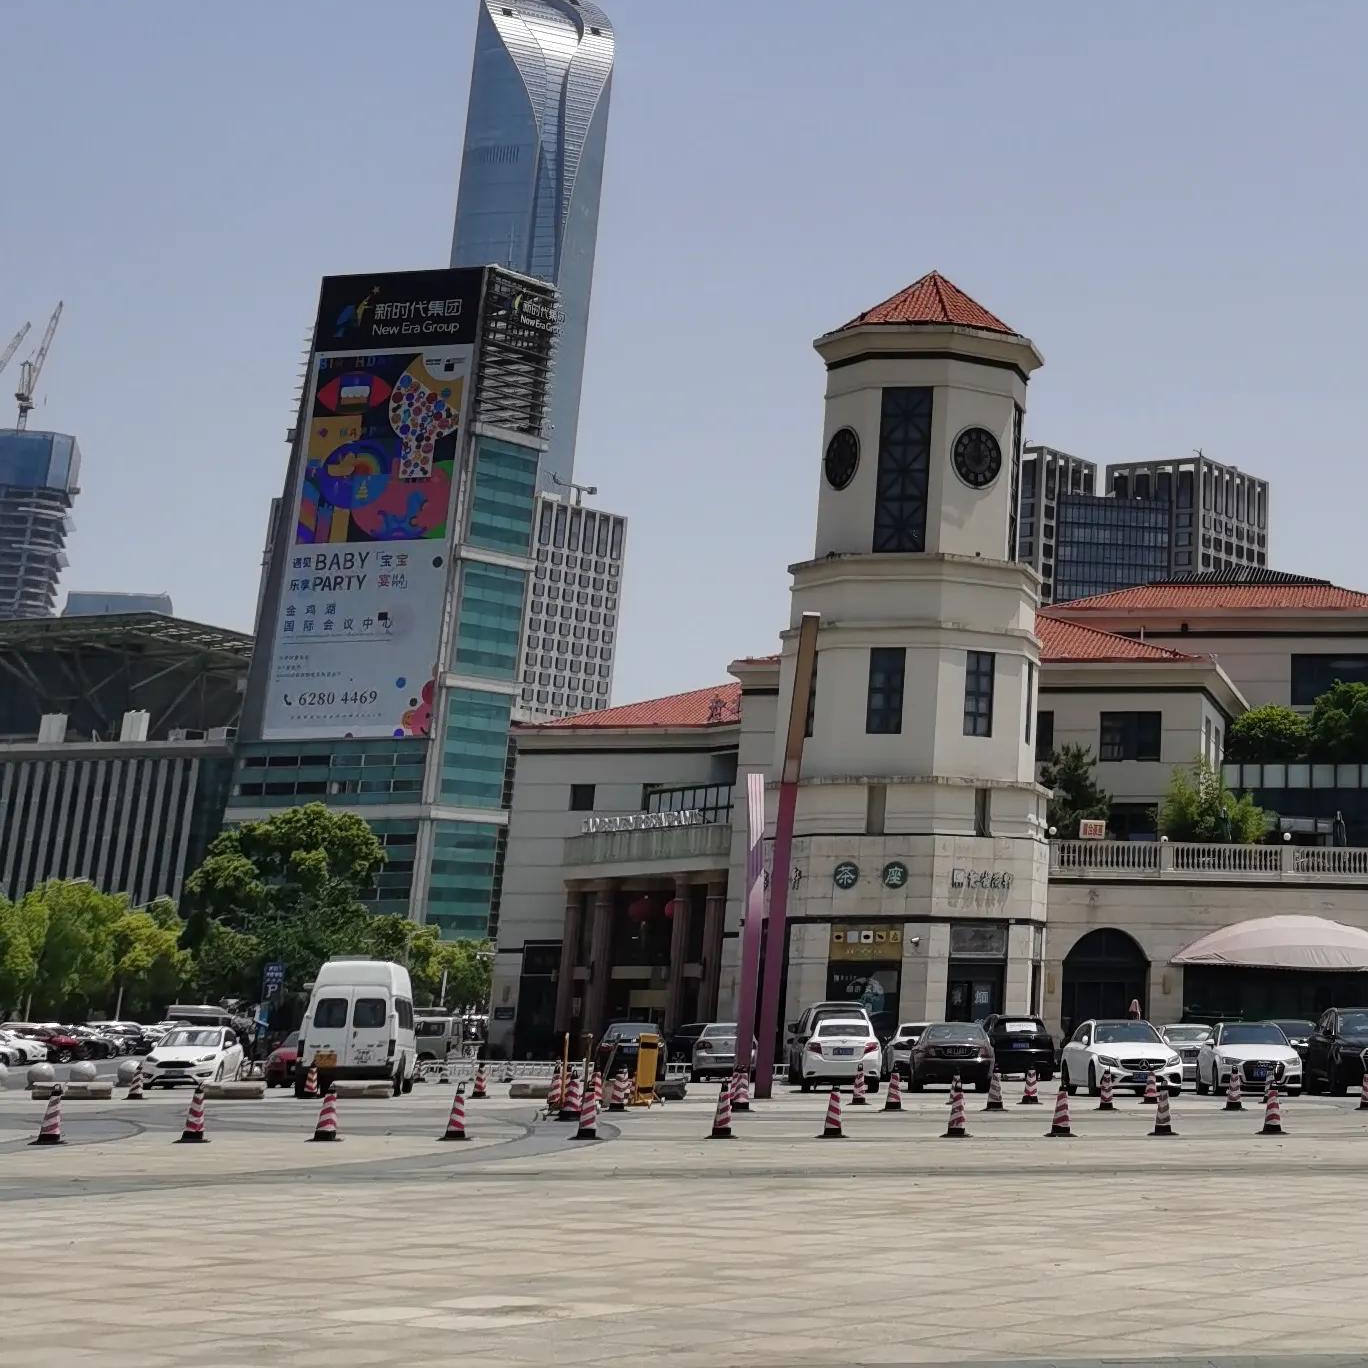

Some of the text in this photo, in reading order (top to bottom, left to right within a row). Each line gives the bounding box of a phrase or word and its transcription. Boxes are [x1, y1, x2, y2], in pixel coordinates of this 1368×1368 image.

[375, 299, 462, 320] 新时代集团
[372, 321, 460, 336] New Era Group
[315, 552, 370, 571] BABY
[312, 574, 367, 592] PARTY
[286, 604, 336, 617] 金鸡湖
[284, 617, 393, 633] 国际会议中心
[298, 690, 377, 706] 6280 4469
[836, 866, 903, 887] 茶座
[266, 983, 278, 998] P
